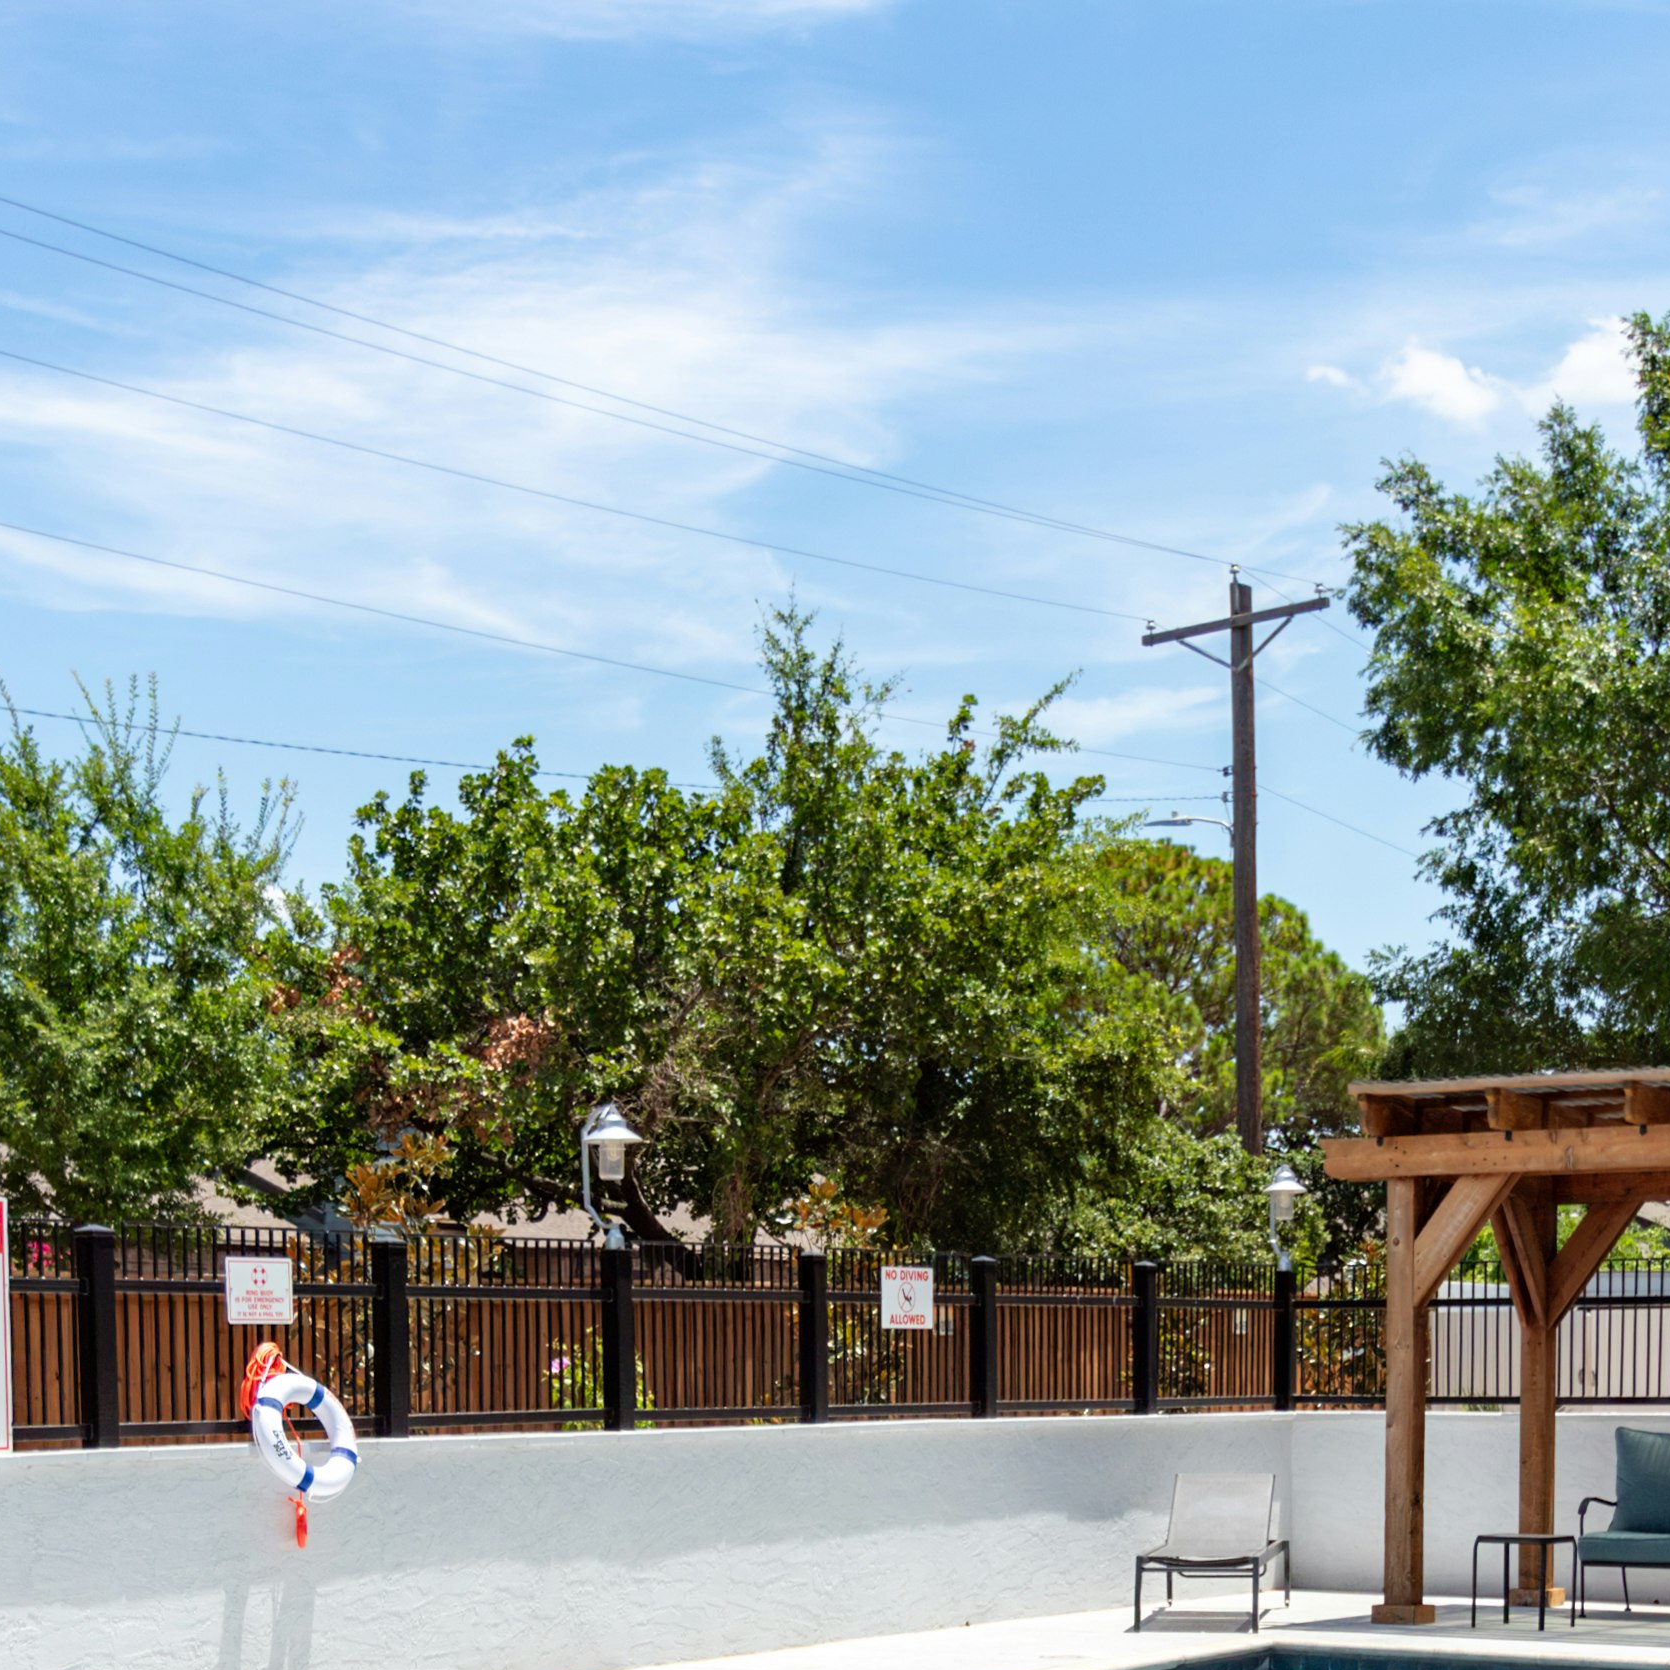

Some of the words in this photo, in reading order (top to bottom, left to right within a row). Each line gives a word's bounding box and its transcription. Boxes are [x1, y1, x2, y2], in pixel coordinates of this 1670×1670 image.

[886, 1270, 897, 1280] NO
[900, 1270, 929, 1281] DIVING
[890, 1314, 926, 1325] ALLOWED
